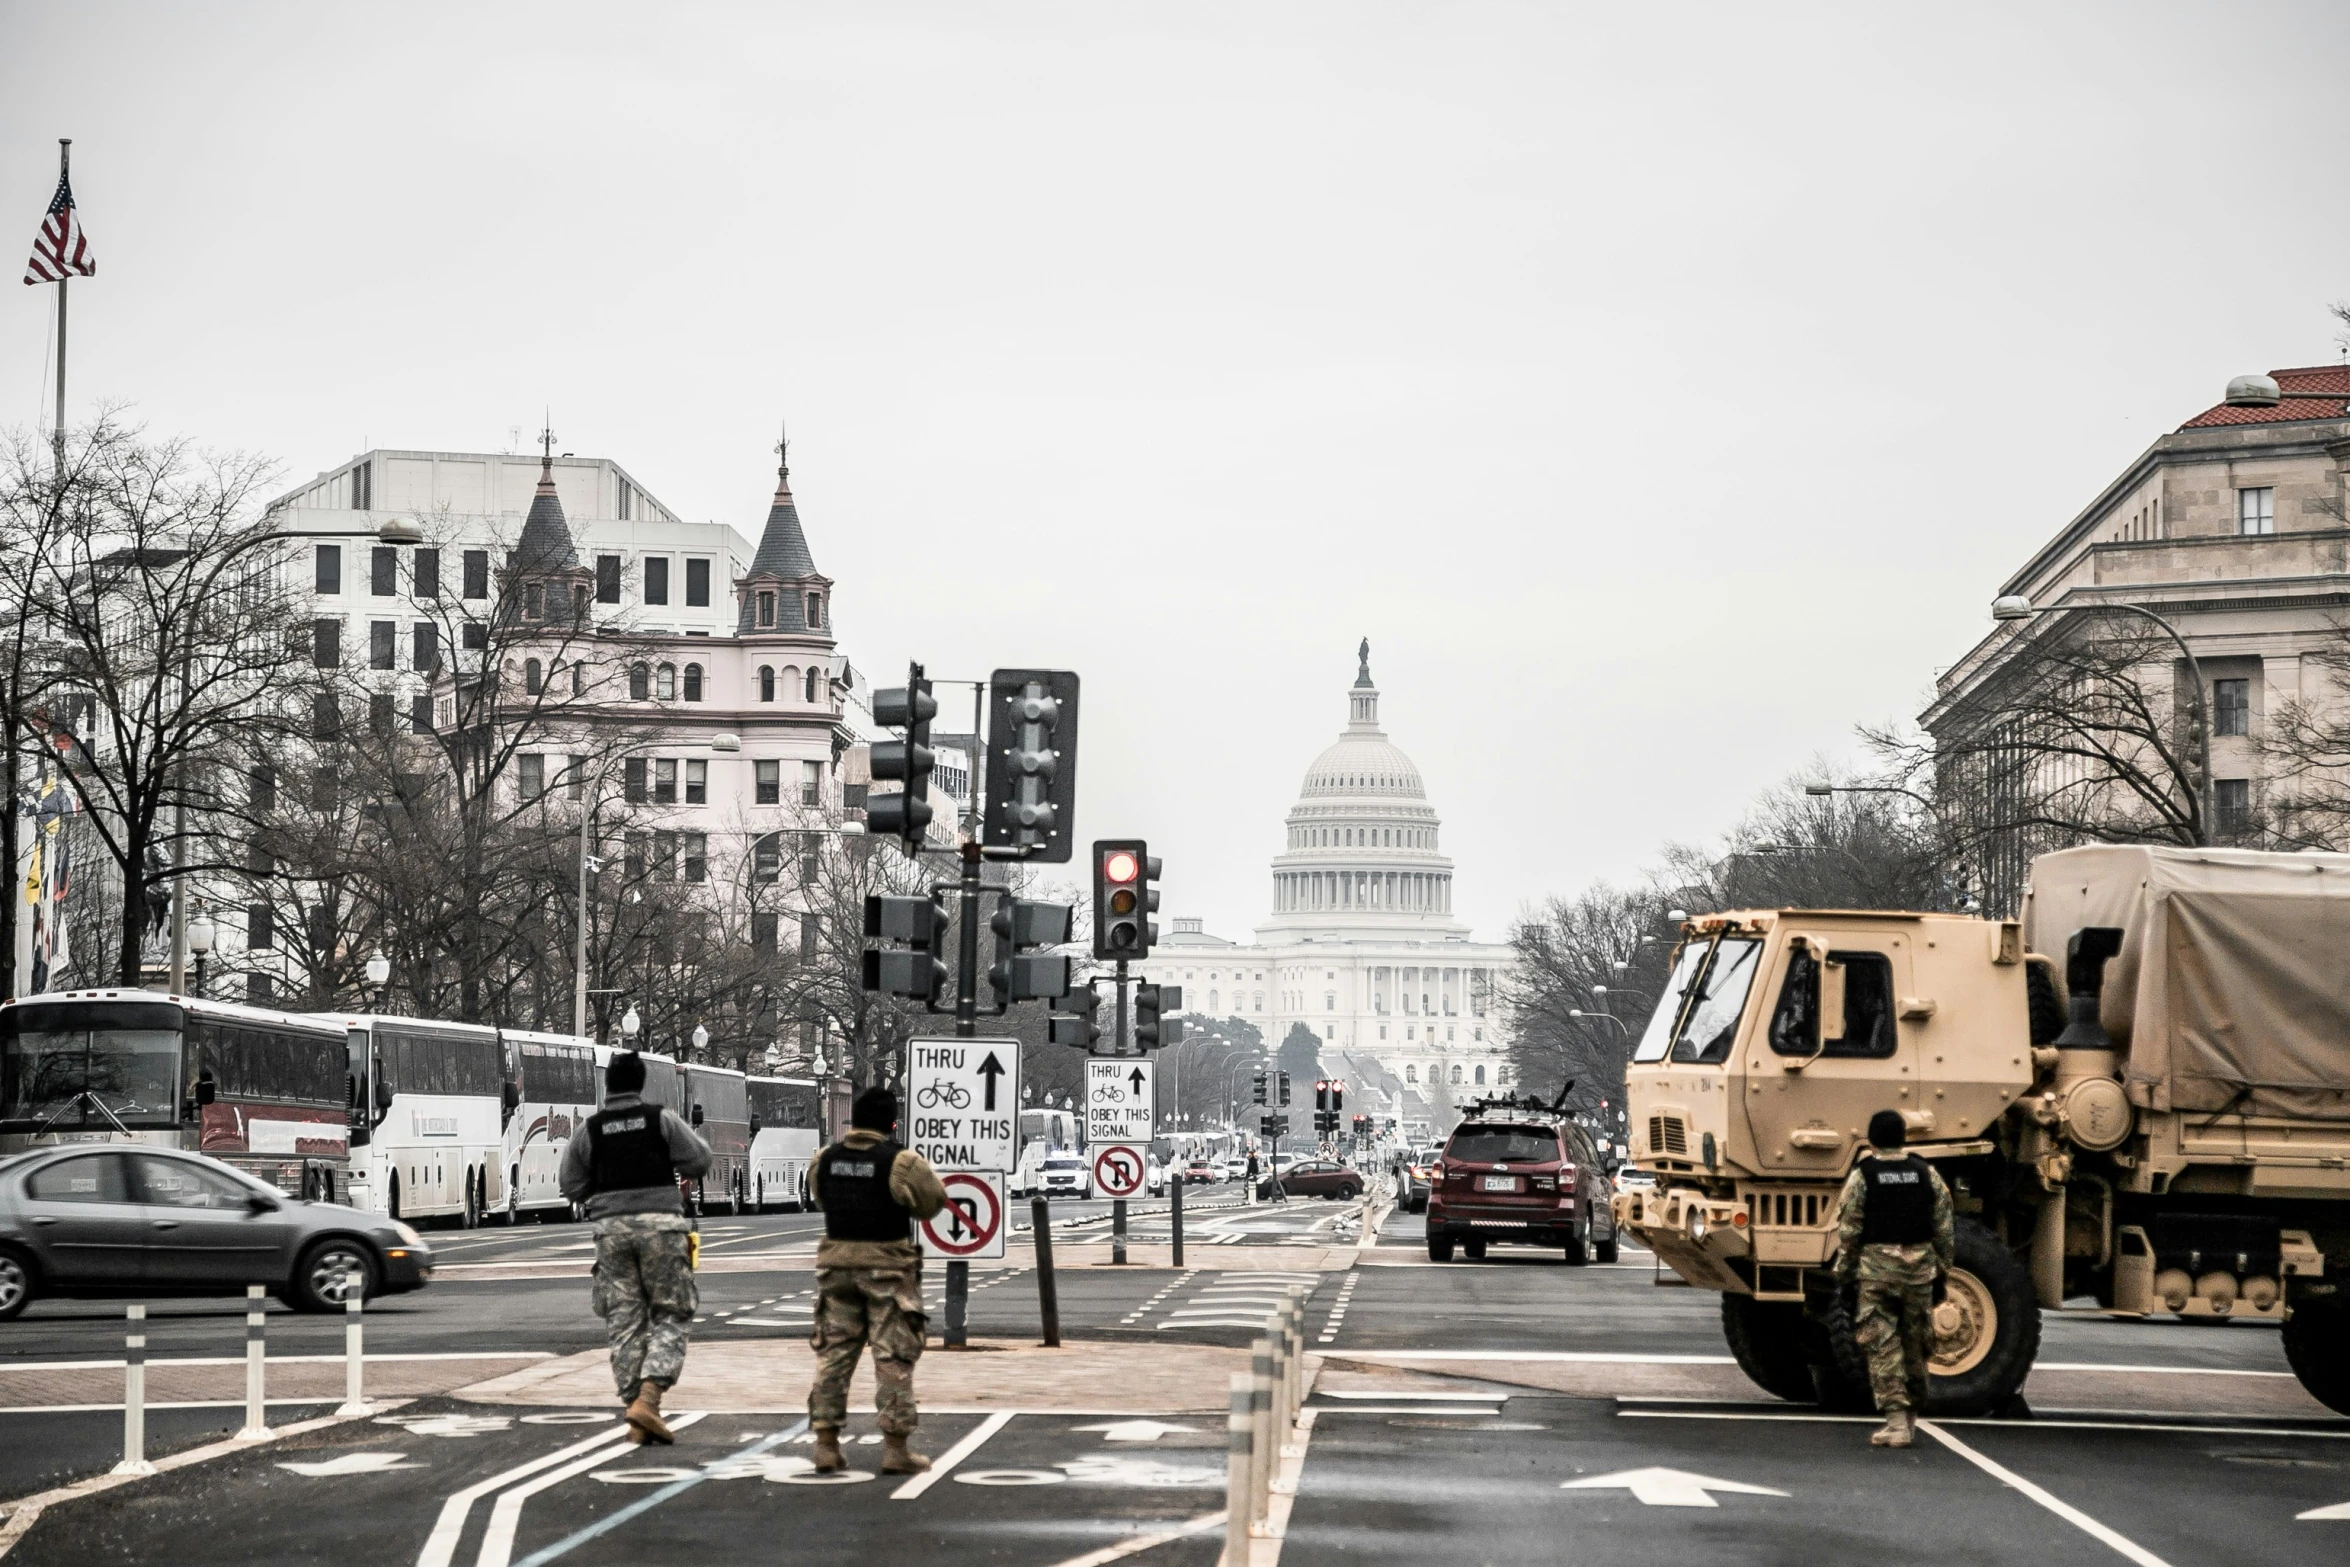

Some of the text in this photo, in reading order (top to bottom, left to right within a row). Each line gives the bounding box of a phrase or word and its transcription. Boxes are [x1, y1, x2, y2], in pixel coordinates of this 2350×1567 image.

[916, 1048, 965, 1069] THRU
[1091, 1065, 1121, 1078] THRU
[1091, 1108, 1150, 1121] OBEY THIS
[915, 1118, 1010, 1140] OBEY THIS
[1091, 1124, 1132, 1137] SIGNAL
[915, 1144, 981, 1165] SIGNAL
